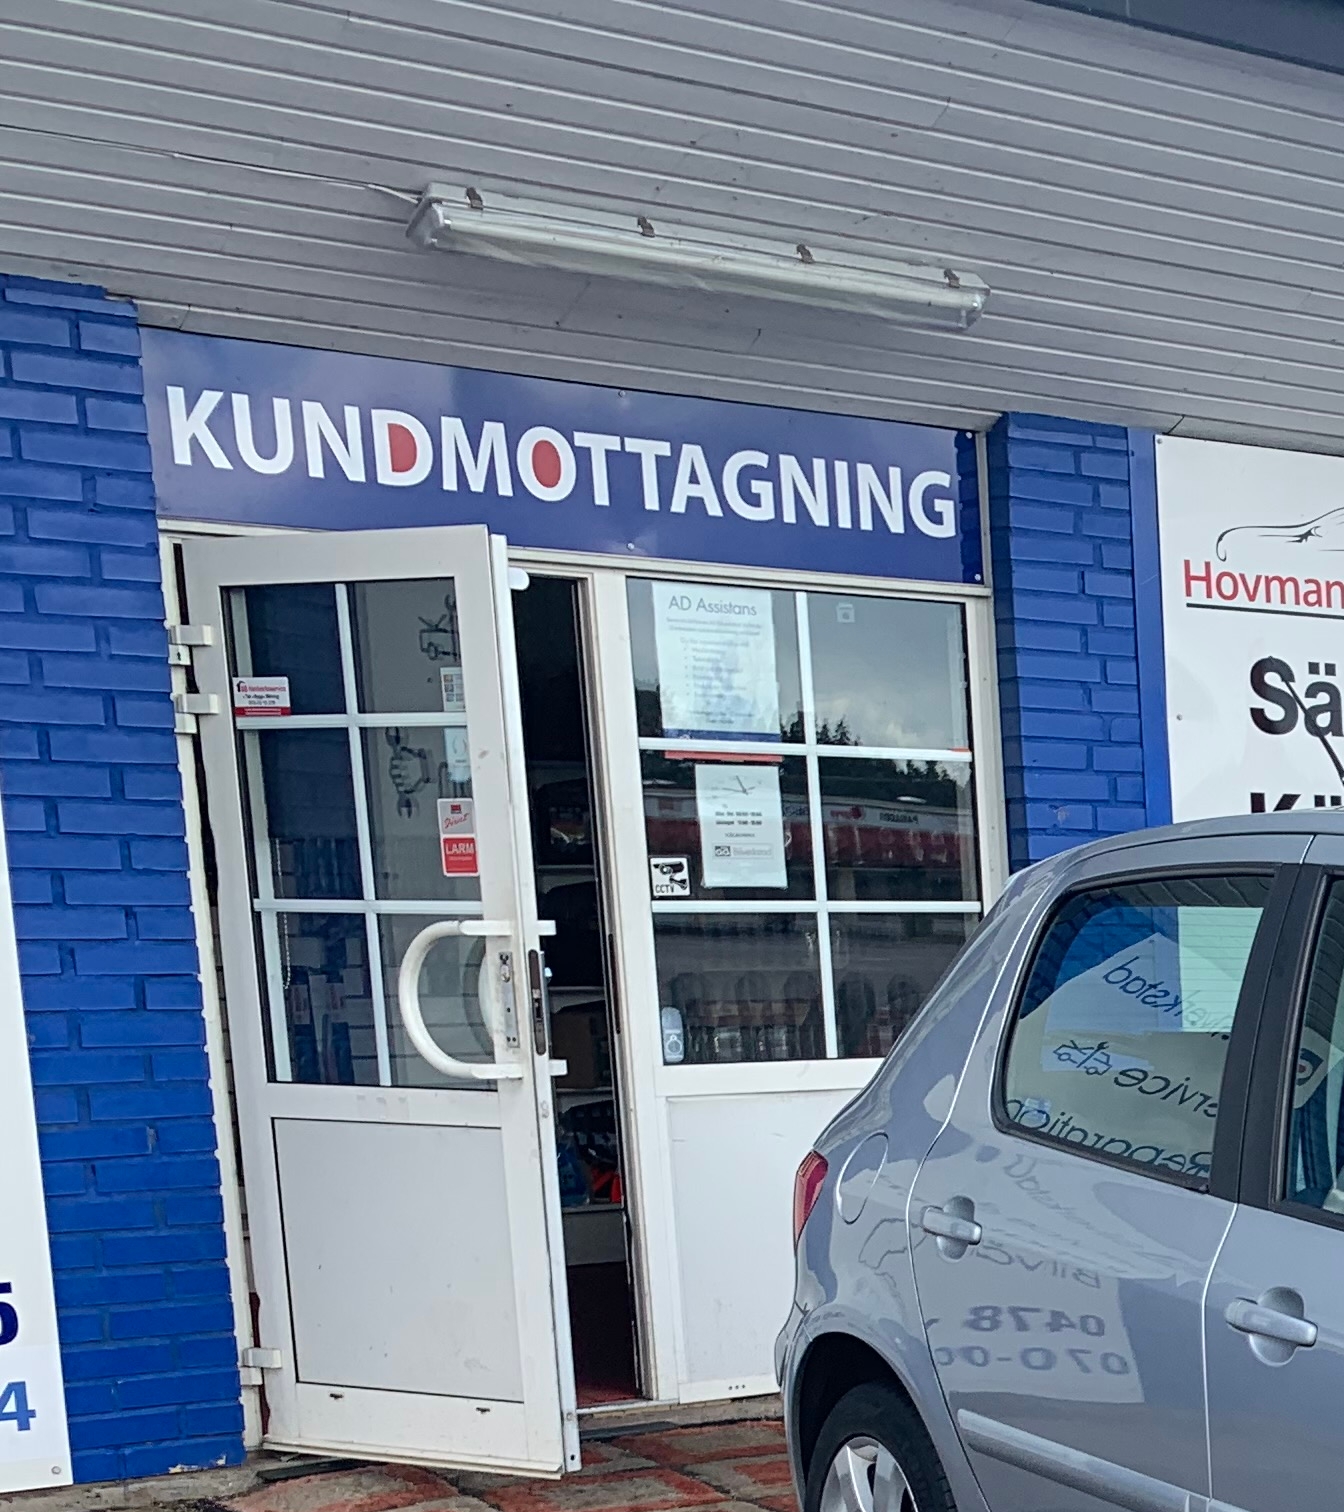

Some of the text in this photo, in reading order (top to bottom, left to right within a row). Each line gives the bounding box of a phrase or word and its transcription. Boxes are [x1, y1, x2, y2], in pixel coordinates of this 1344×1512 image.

[167, 385, 957, 540] KUNDMOTTAGNING
[668, 595, 757, 616] AD Assistans
[445, 842, 475, 855] LARM
[655, 883, 675, 893] CCTV
